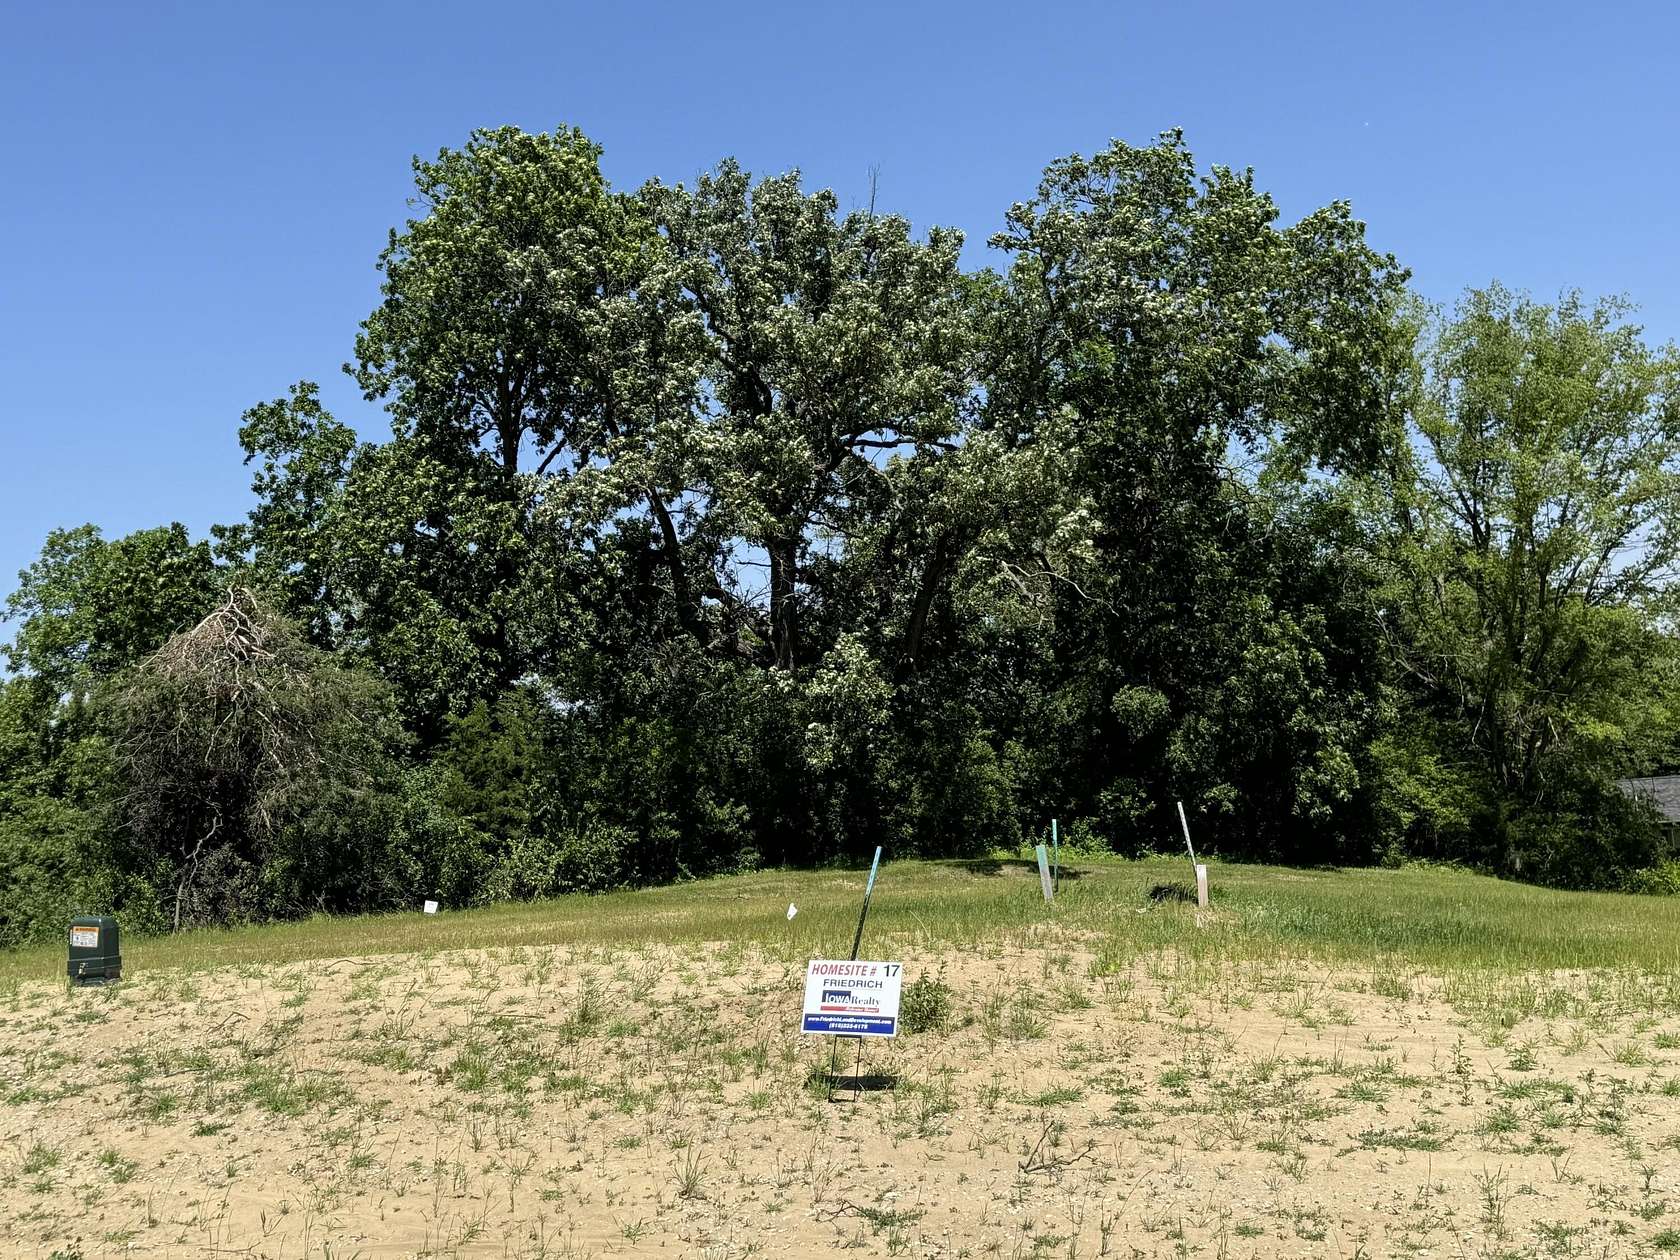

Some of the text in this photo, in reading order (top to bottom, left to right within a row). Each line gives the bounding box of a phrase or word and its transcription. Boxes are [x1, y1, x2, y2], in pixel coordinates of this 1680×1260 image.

[812, 964, 900, 977] HOMESITE # 17
[823, 979, 883, 988] FRIEDRICH
